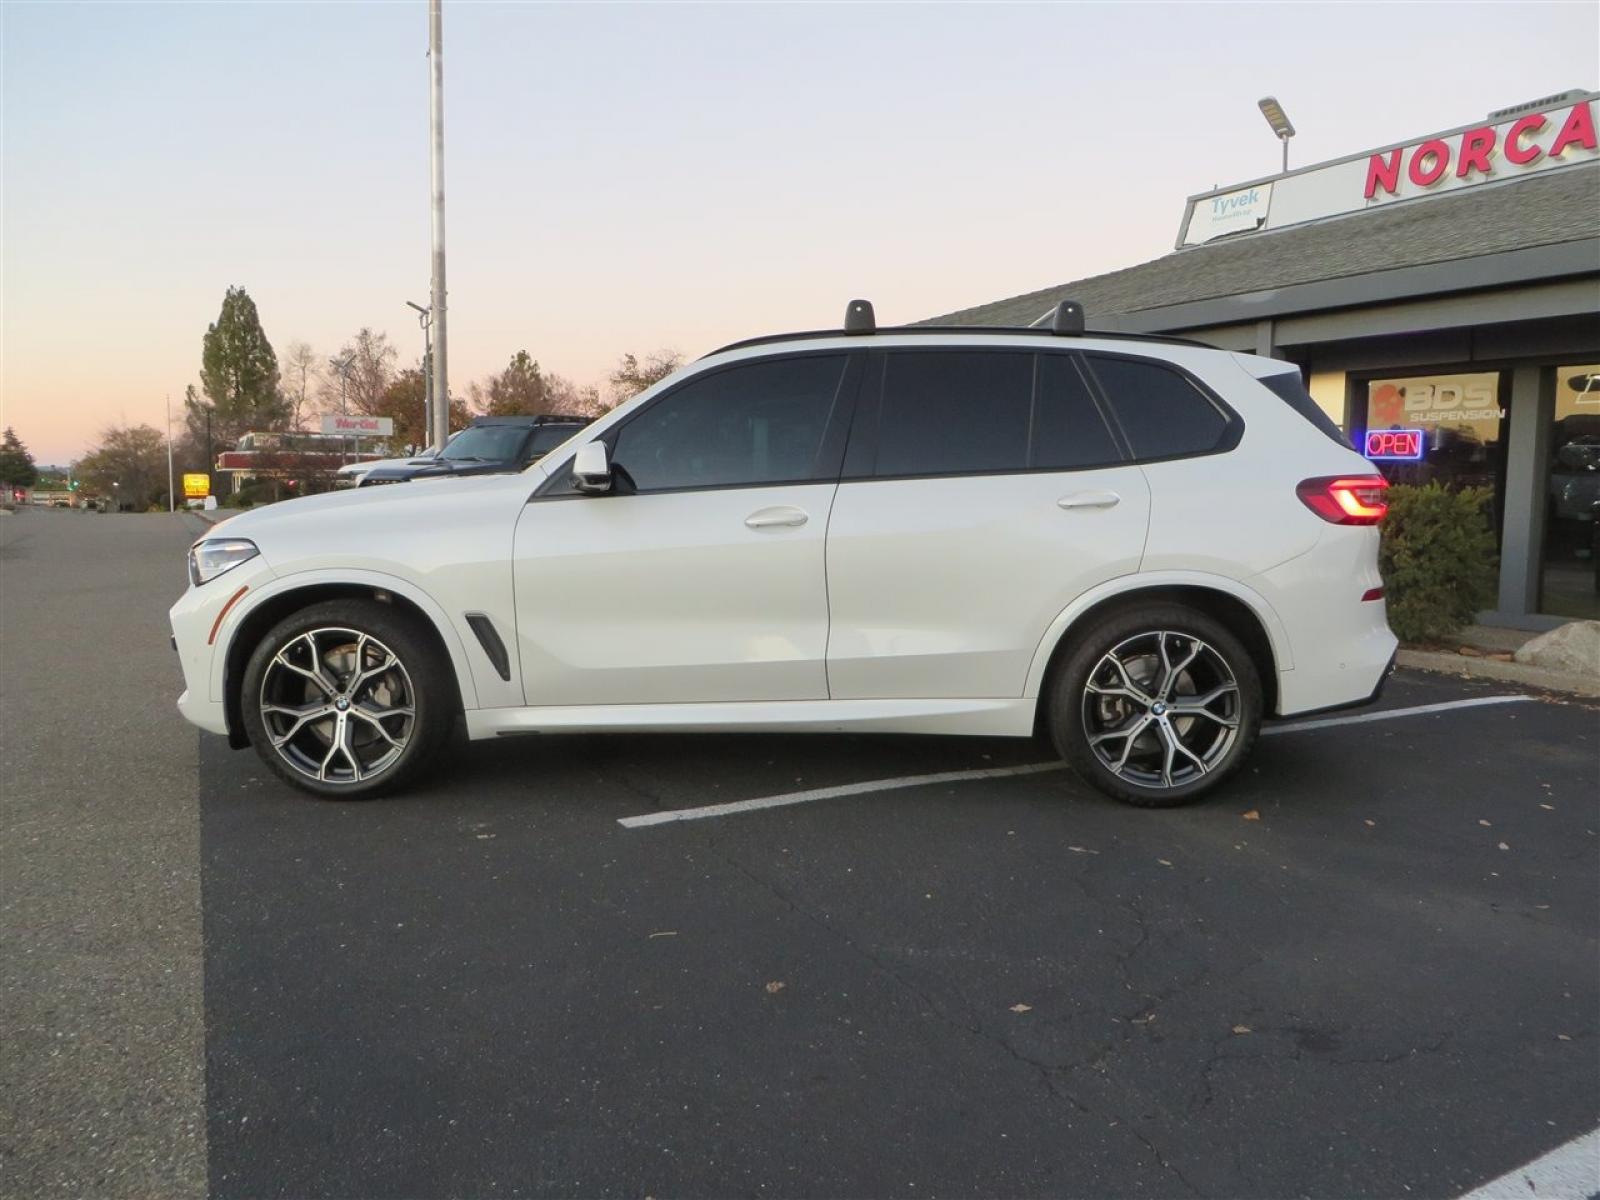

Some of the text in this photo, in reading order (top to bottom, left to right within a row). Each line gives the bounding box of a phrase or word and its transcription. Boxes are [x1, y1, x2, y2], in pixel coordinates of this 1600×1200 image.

[1364, 101, 1597, 199] NORCA
[1212, 189, 1259, 215] Tyvek
[1405, 383, 1492, 411] BDS
[1410, 408, 1505, 422] SUSPENSION
[1368, 433, 1420, 454] OPEN
